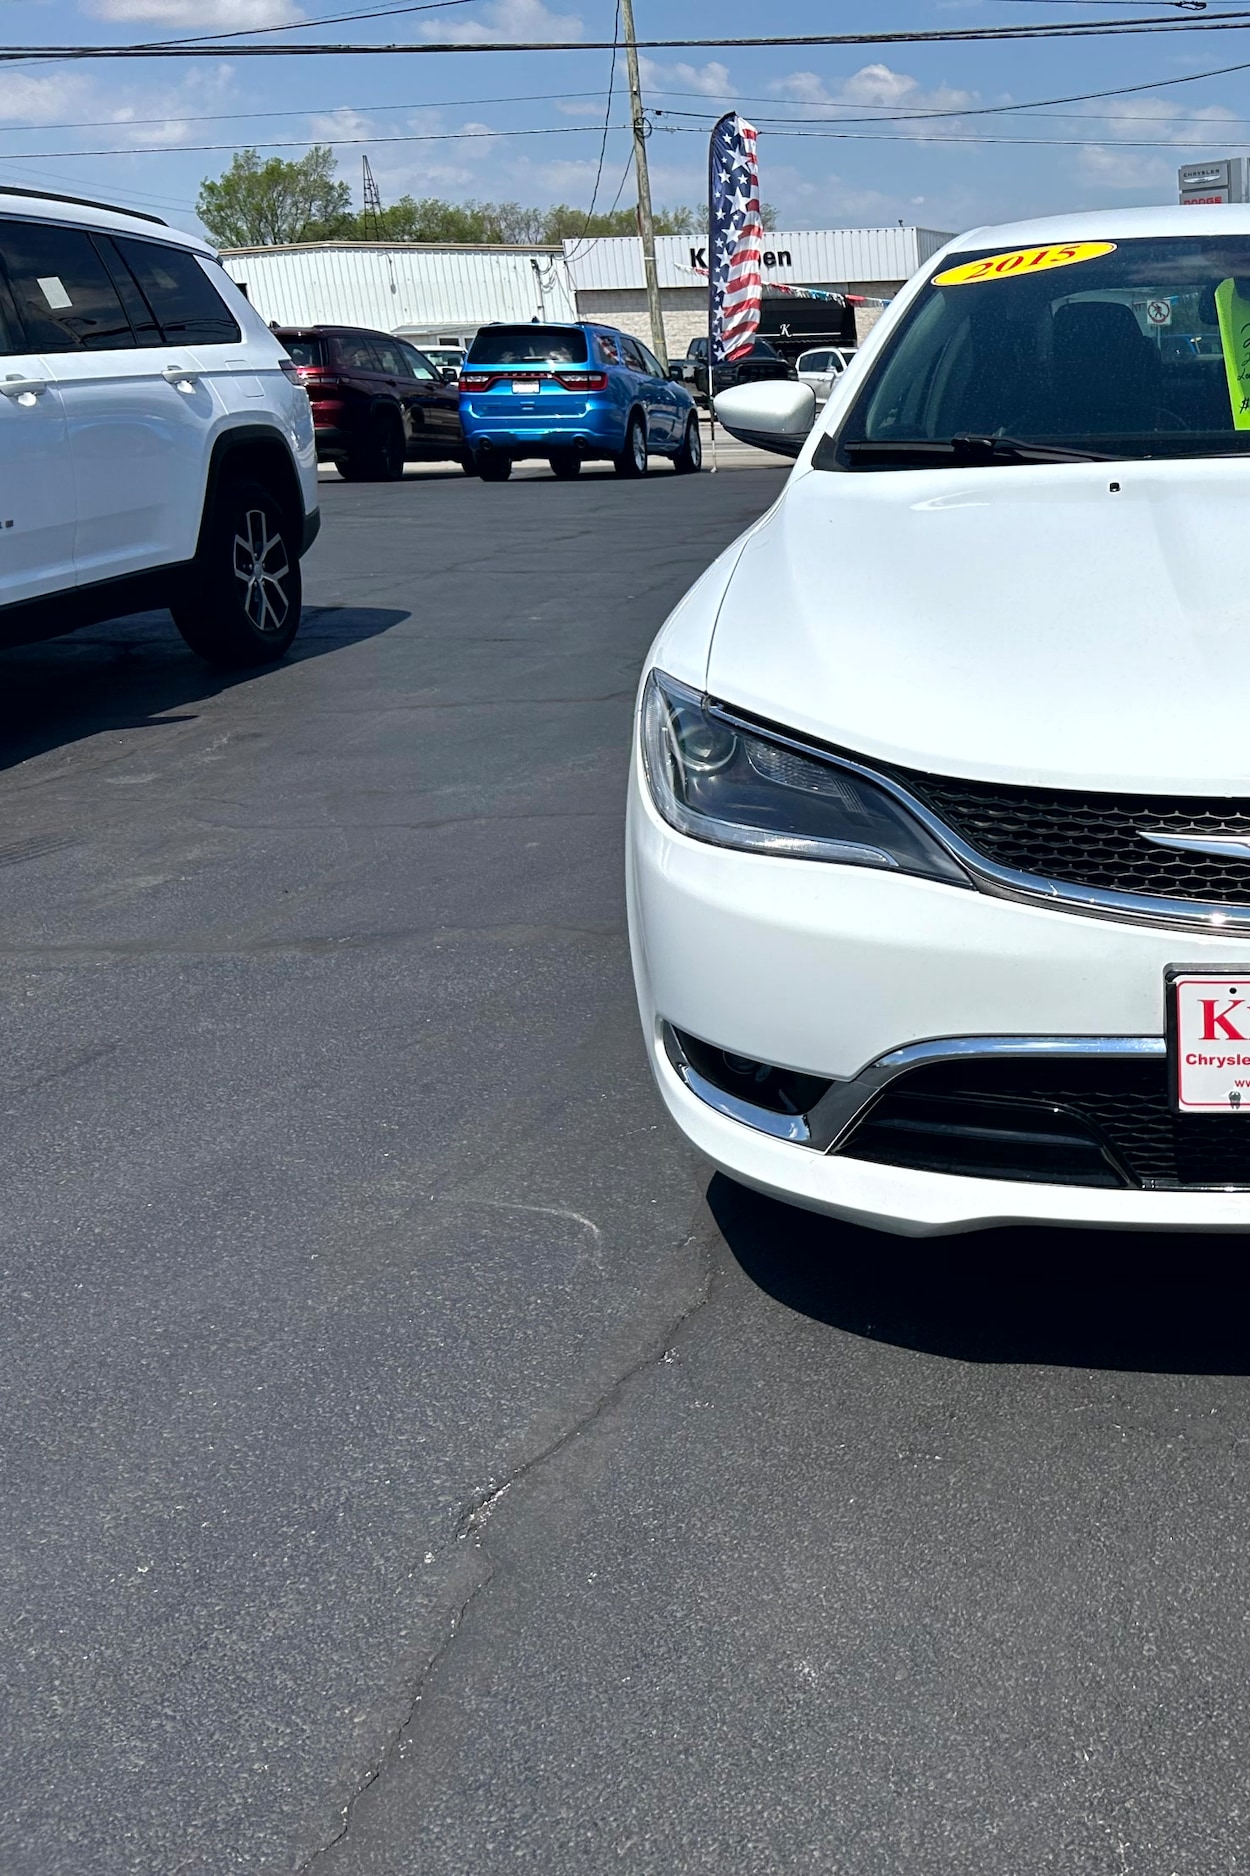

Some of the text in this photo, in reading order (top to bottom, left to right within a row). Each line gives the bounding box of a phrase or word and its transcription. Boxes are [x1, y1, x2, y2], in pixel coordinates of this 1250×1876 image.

[1183, 168, 1220, 178] CHRYSLER
[963, 245, 1081, 281] 2015
[779, 323, 793, 338] K
